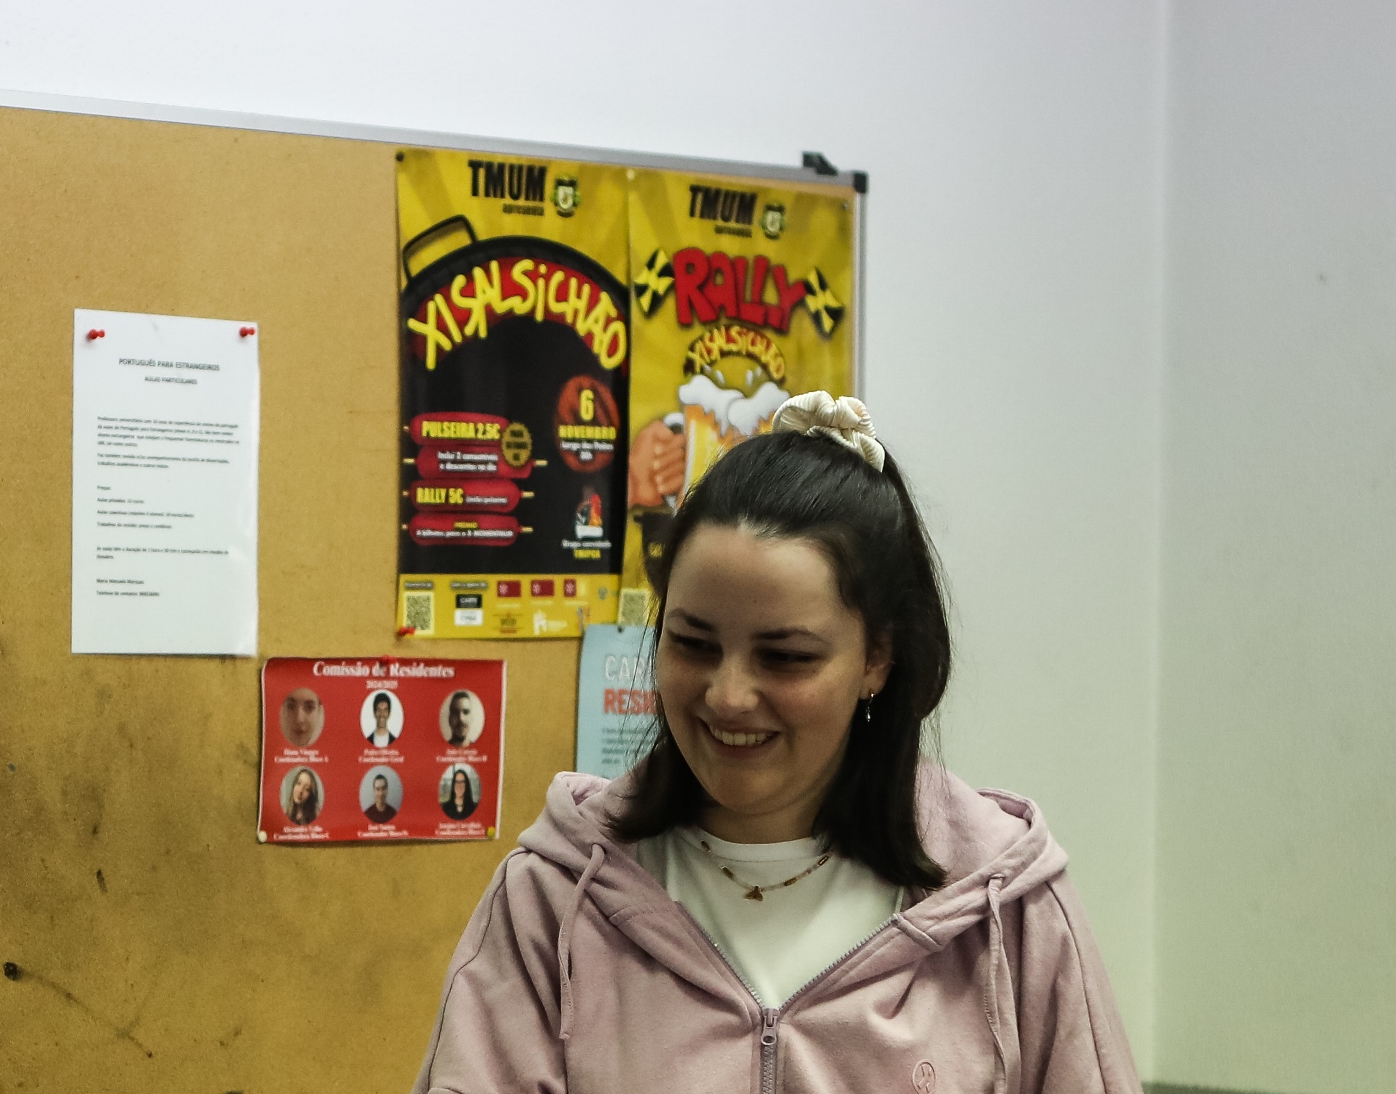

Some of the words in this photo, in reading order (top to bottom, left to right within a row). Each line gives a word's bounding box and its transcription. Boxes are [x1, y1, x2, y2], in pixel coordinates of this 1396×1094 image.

[468, 160, 546, 202] TMUM
[690, 184, 757, 225] TMUM
[673, 247, 806, 331] RALLY
[118, 358, 156, 367] PORTUGUÊS
[157, 360, 174, 368] PARA
[175, 361, 220, 371] ESTRANGEIROS
[161, 376, 198, 385] PARTICULARES
[579, 389, 594, 421] 6
[421, 420, 476, 439] PULSEIRA
[558, 425, 617, 440] NOVEMBRO
[416, 487, 447, 504] RALLY
[312, 661, 369, 676] Comissão
[371, 662, 386, 677] de
[389, 663, 455, 678] Residentes
